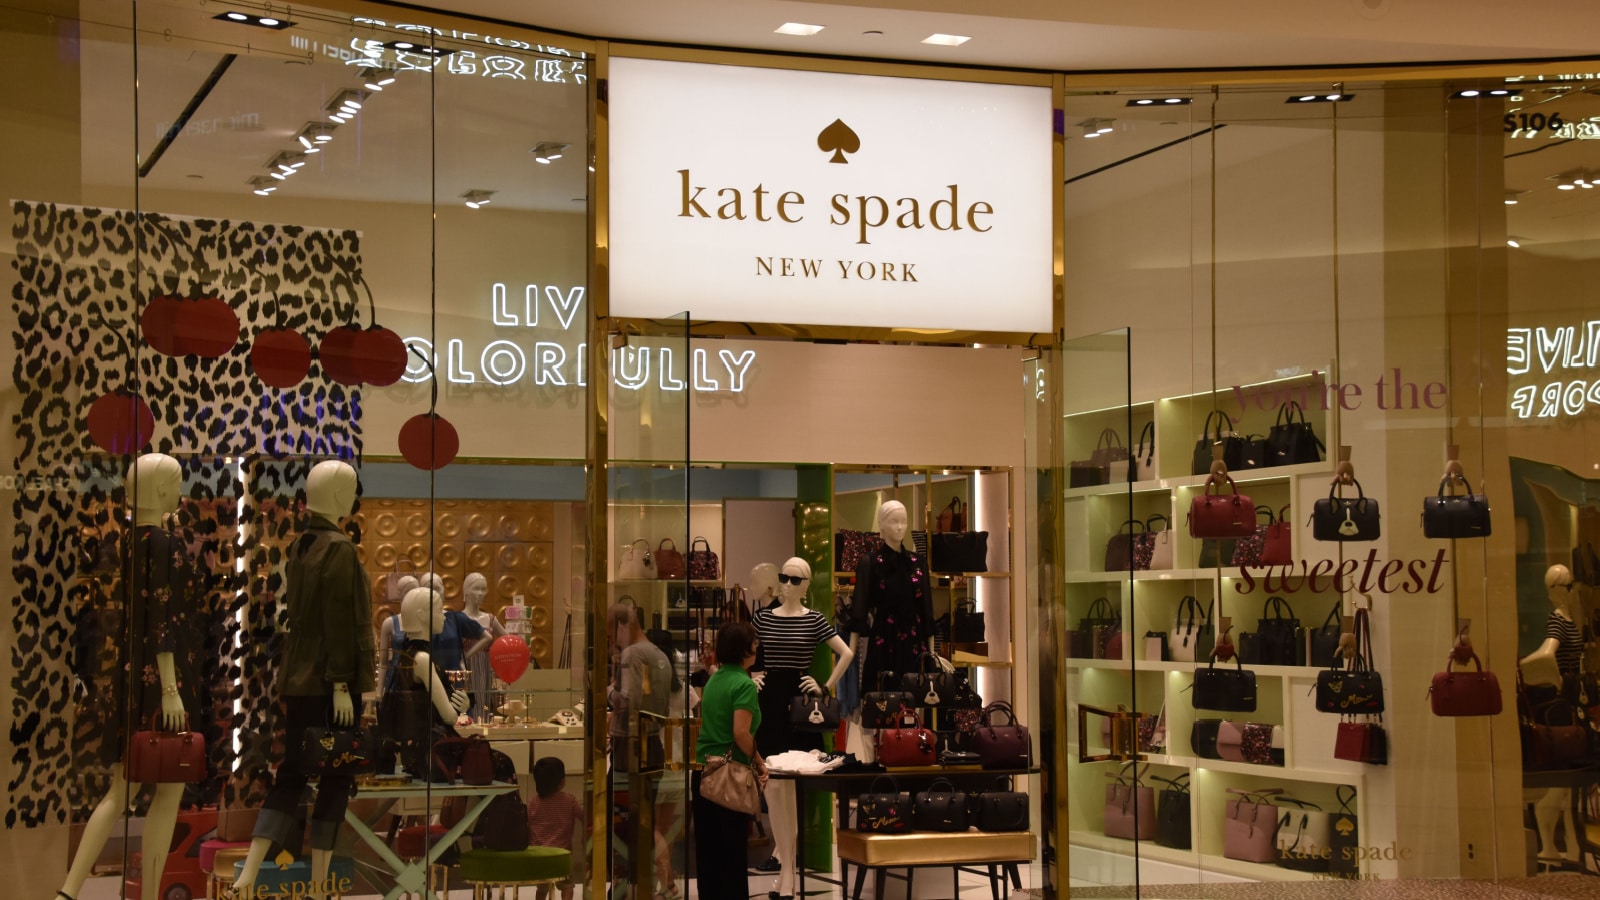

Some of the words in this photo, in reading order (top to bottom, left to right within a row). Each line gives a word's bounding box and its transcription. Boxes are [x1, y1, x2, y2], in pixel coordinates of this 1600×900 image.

[1503, 112, 1563, 133] S106
[677, 169, 805, 222] kate
[830, 184, 994, 244] spade
[755, 256, 823, 278] NEW
[838, 260, 919, 282] YORK
[492, 283, 585, 329] LIV
[402, 336, 756, 392] OLORULLY
[1230, 370, 1362, 424] you're
[1375, 368, 1448, 410] the
[1234, 548, 1450, 594] sweetest
[1279, 840, 1333, 860] kate
[1341, 841, 1413, 867] spade
[279, 871, 353, 900] spade
[1312, 872, 1341, 881] NEW
[1345, 873, 1380, 881] YORK
